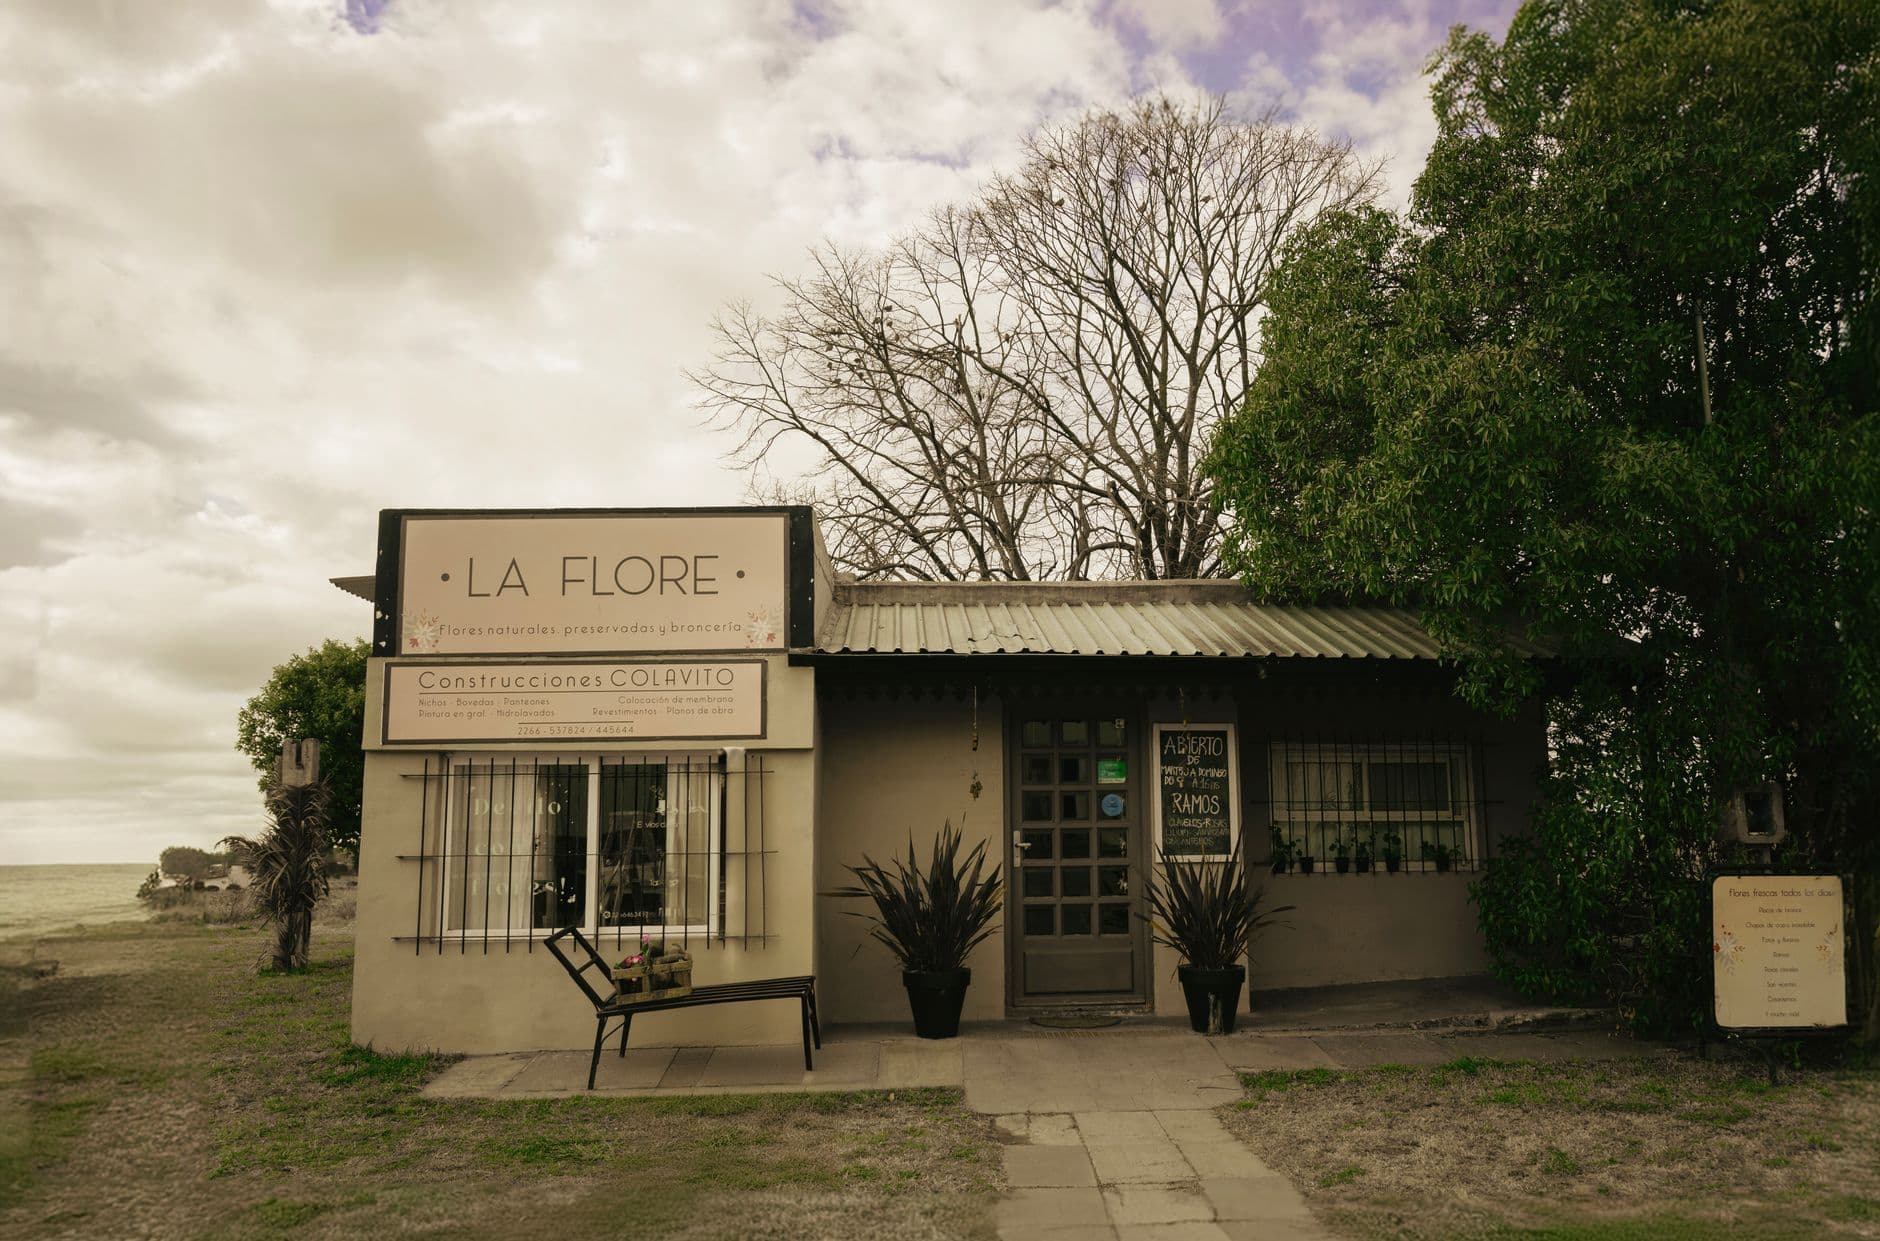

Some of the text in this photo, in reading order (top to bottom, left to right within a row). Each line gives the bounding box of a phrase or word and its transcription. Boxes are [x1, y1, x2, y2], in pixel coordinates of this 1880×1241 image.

[468, 555, 719, 597] LA FLORE
[439, 624, 483, 636] Flores
[564, 622, 655, 637] preservadas
[659, 624, 666, 636] y
[671, 621, 741, 633] broncería
[418, 668, 734, 689] Construcciones COLAVITO
[418, 699, 447, 707] Nichos
[503, 697, 550, 706] Panteones
[618, 695, 734, 705] Colocación de membrana
[419, 709, 450, 718] Pintura
[496, 709, 555, 718] Hidrolavados
[592, 706, 734, 716] Revestimientos Planos de obra
[518, 726, 541, 735] 2266
[550, 726, 585, 735] 537824
[596, 726, 634, 735] 445644
[1164, 735, 1223, 756] ABIERTO
[1171, 792, 1220, 815] RAMOS
[1728, 888, 1750, 898] Flores
[1753, 888, 1778, 898] frescas
[1782, 888, 1801, 897] todos
